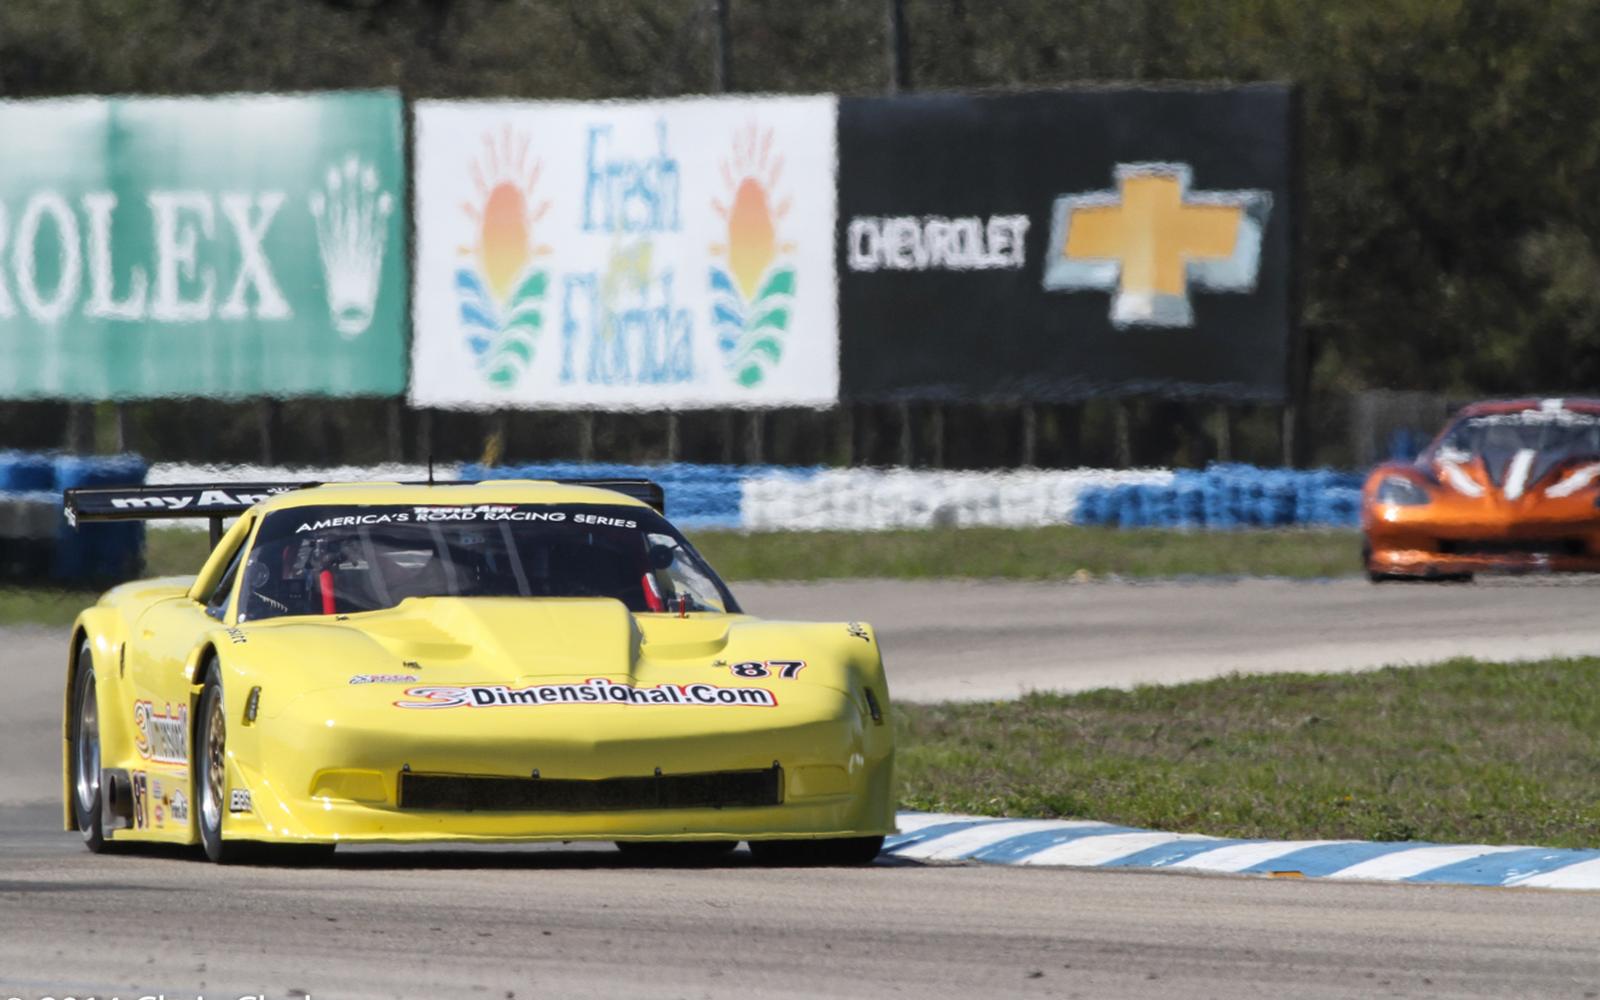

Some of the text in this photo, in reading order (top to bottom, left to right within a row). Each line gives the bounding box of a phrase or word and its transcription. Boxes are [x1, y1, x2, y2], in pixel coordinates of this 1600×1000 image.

[581, 117, 682, 234] Fresh
[0, 188, 293, 323] OLEX
[847, 214, 1031, 272] CHEVROLET
[560, 267, 695, 384] Florida
[295, 511, 638, 533] AMERICA'S ROAD RACING SERIES
[732, 660, 807, 679] 87
[133, 769, 149, 829] 87
